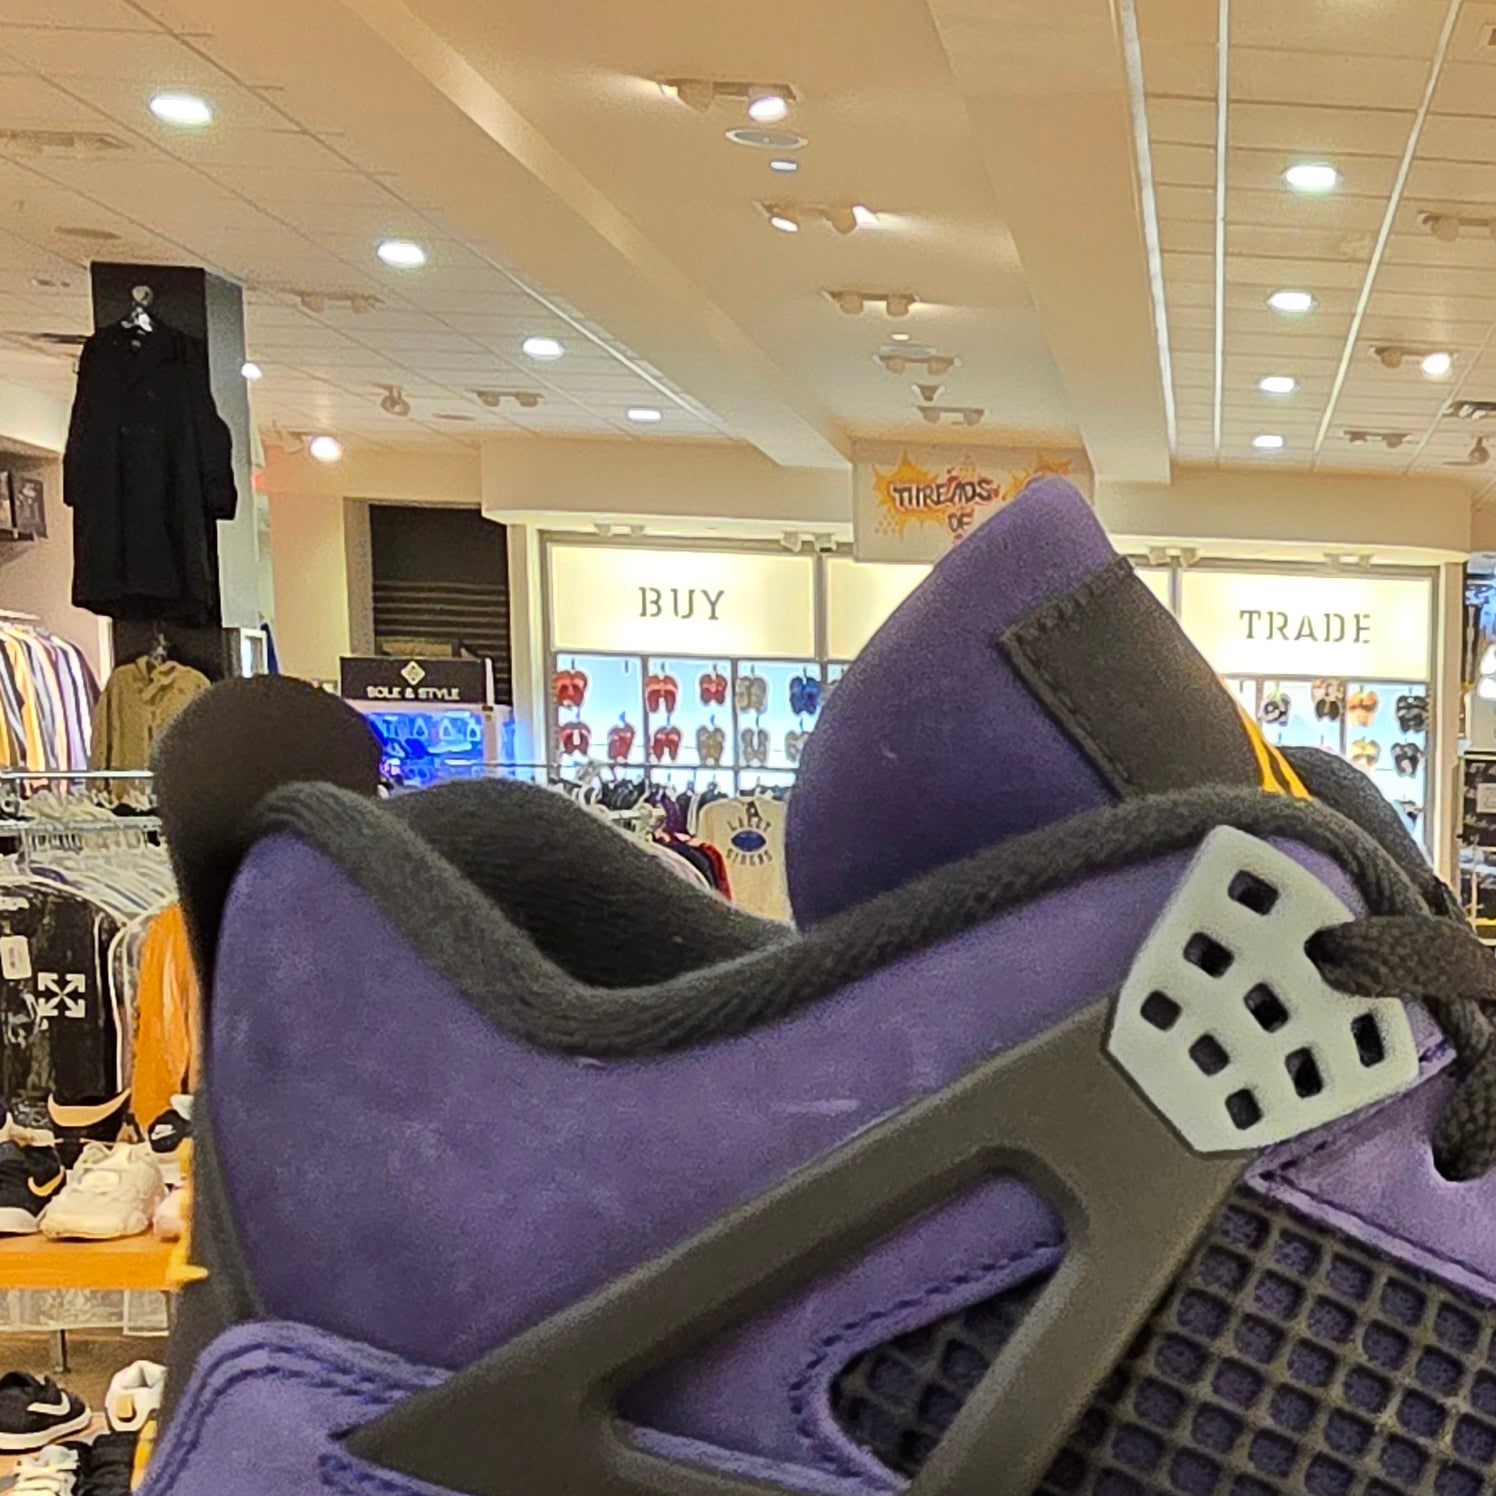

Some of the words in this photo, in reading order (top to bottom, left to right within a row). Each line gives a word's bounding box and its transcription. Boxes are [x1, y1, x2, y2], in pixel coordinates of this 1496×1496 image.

[892, 477, 994, 508] THREADS
[638, 586, 725, 620] BUY
[1239, 610, 1370, 644] TRADE
[366, 685, 401, 699] SOLE
[404, 687, 415, 699] &
[418, 687, 460, 700] STYLE
